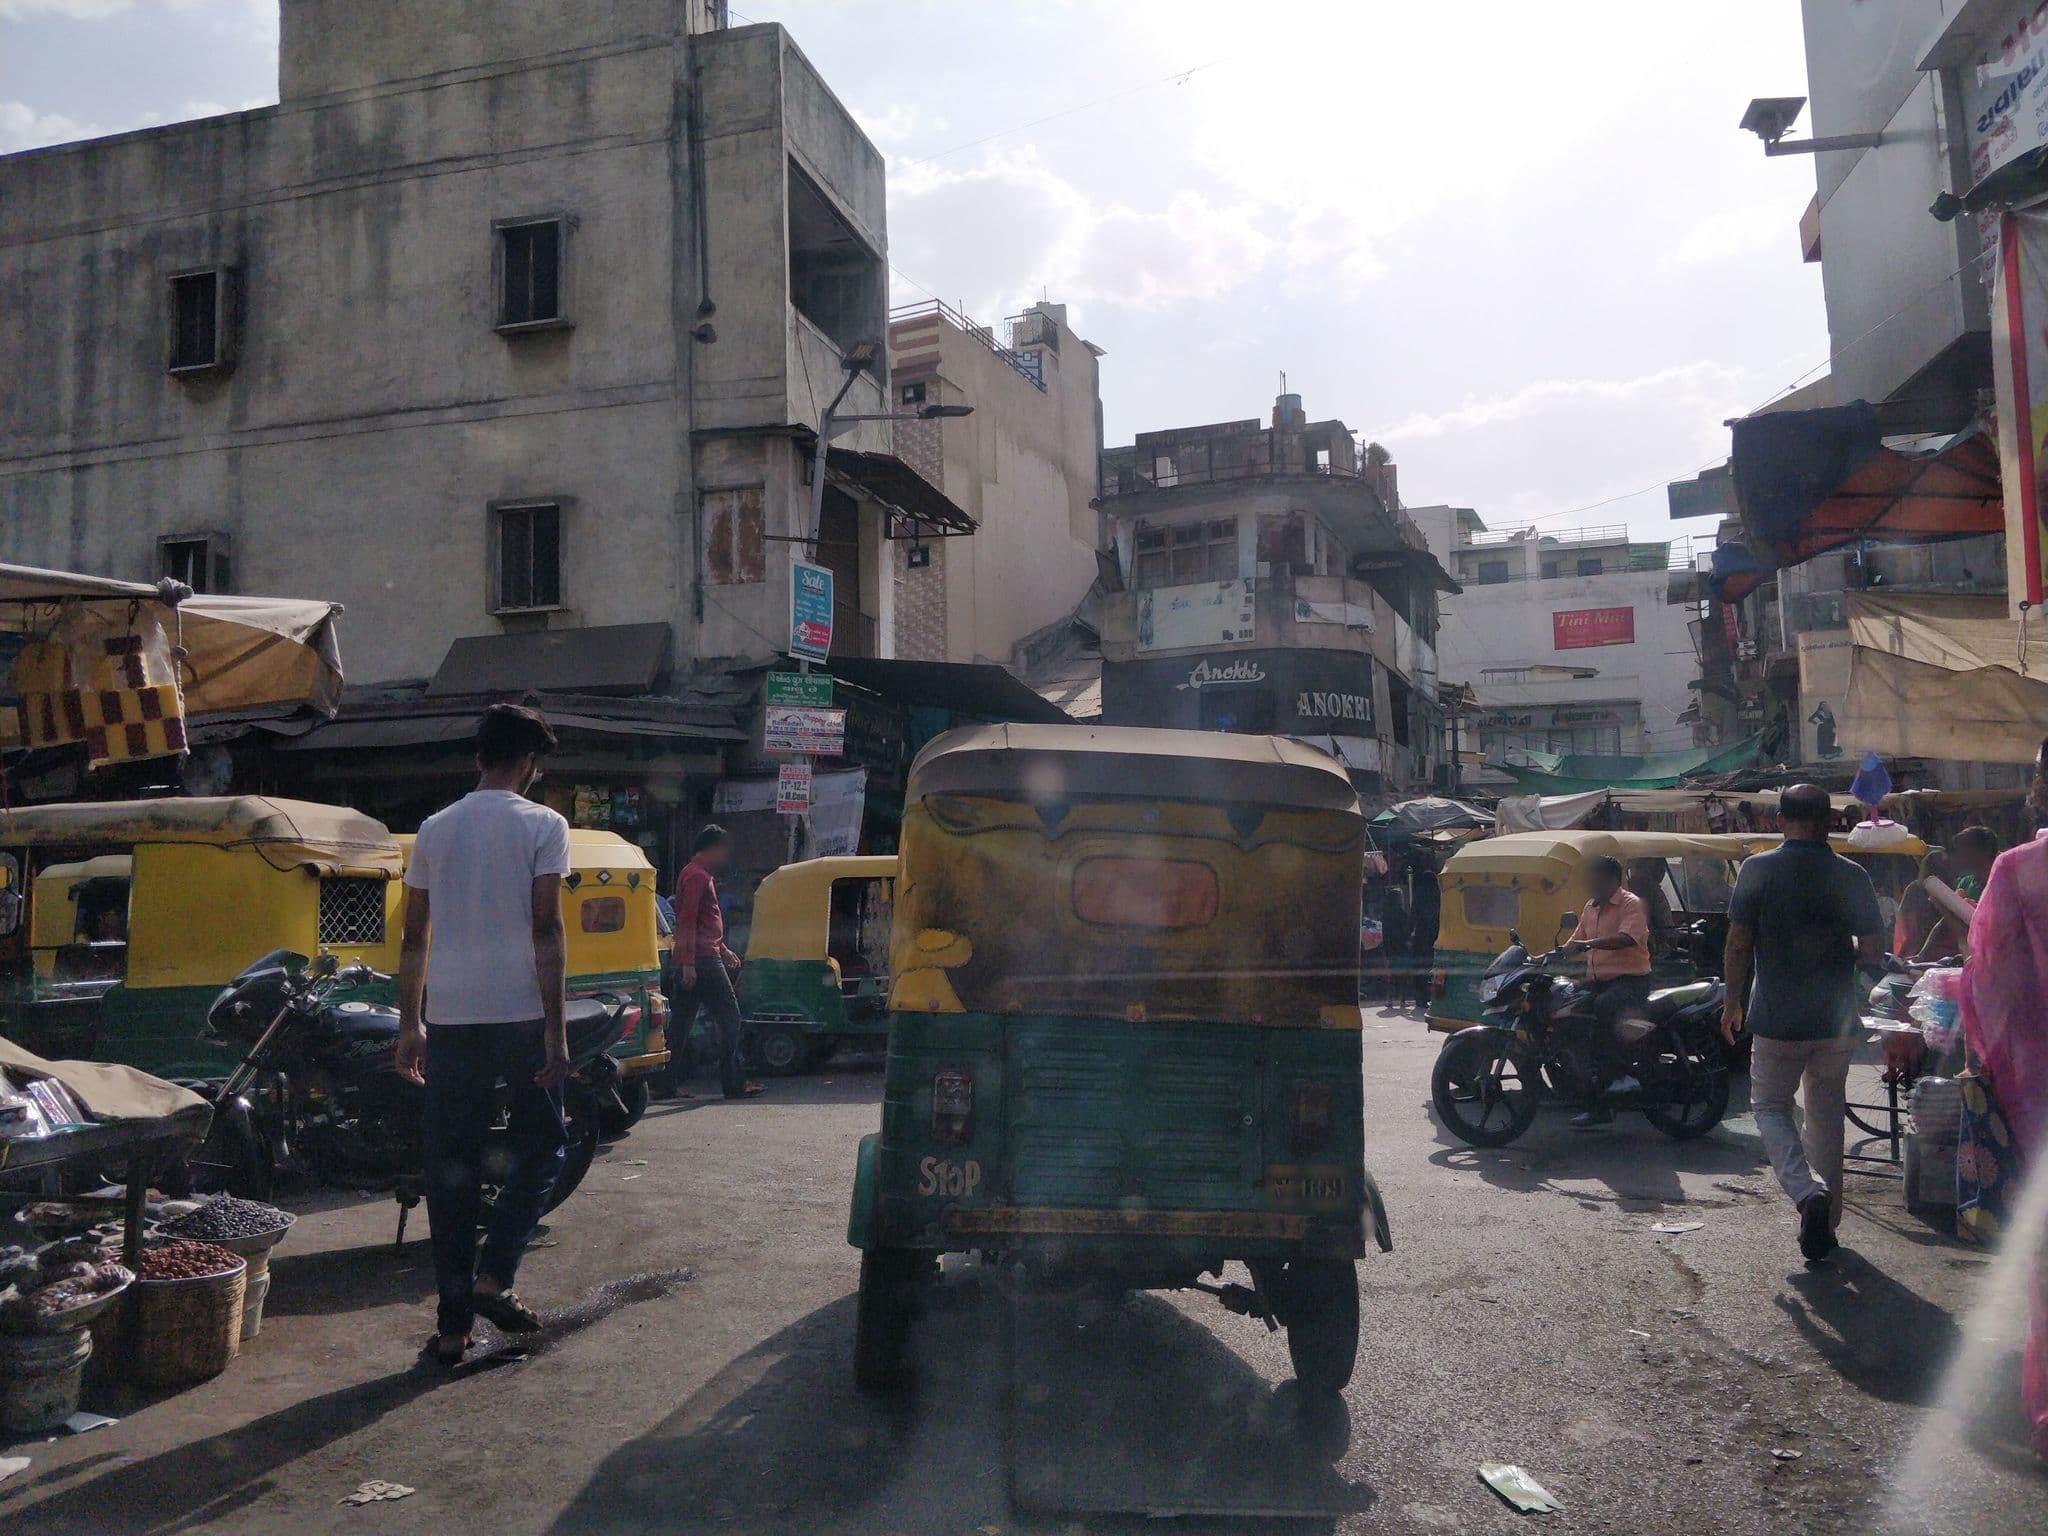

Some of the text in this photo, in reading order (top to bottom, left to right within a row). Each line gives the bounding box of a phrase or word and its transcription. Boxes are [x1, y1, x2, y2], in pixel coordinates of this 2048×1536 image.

[802, 571, 825, 590] Sale
[1177, 659, 1266, 689] Anokhi
[1297, 692, 1371, 721] ANOKHI
